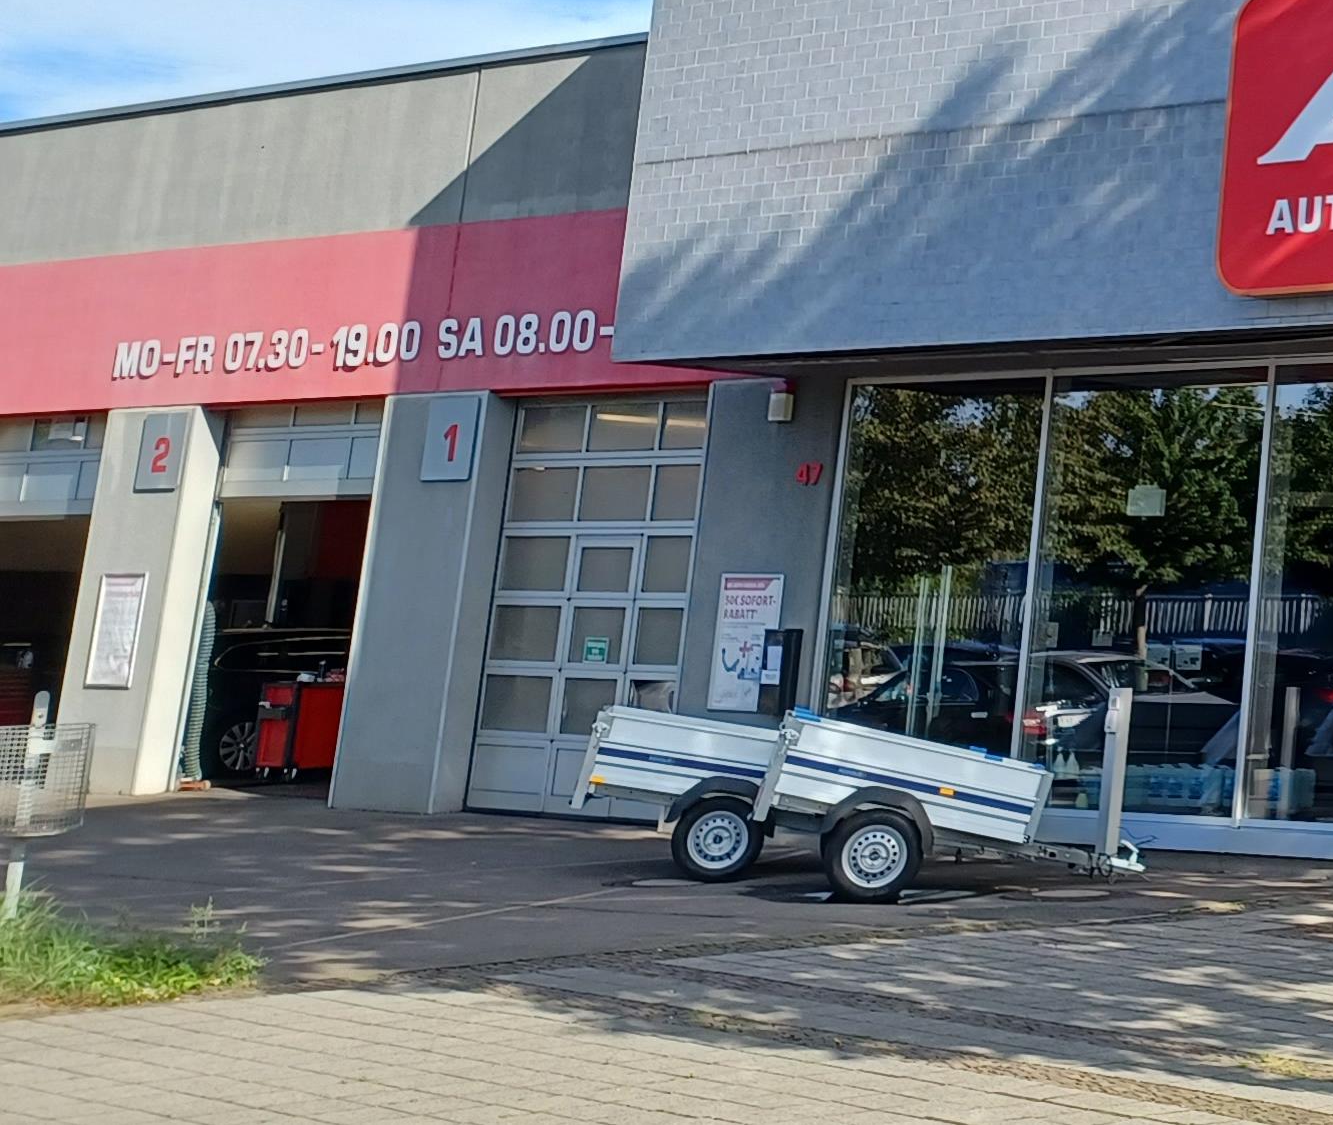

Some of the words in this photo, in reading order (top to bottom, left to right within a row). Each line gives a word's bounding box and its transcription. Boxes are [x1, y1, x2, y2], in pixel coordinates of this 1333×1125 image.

[112, 336, 216, 380] MO-FR
[437, 316, 484, 359] SA
[151, 437, 171, 473] 2
[442, 423, 460, 464] 1
[795, 461, 823, 486] 47
